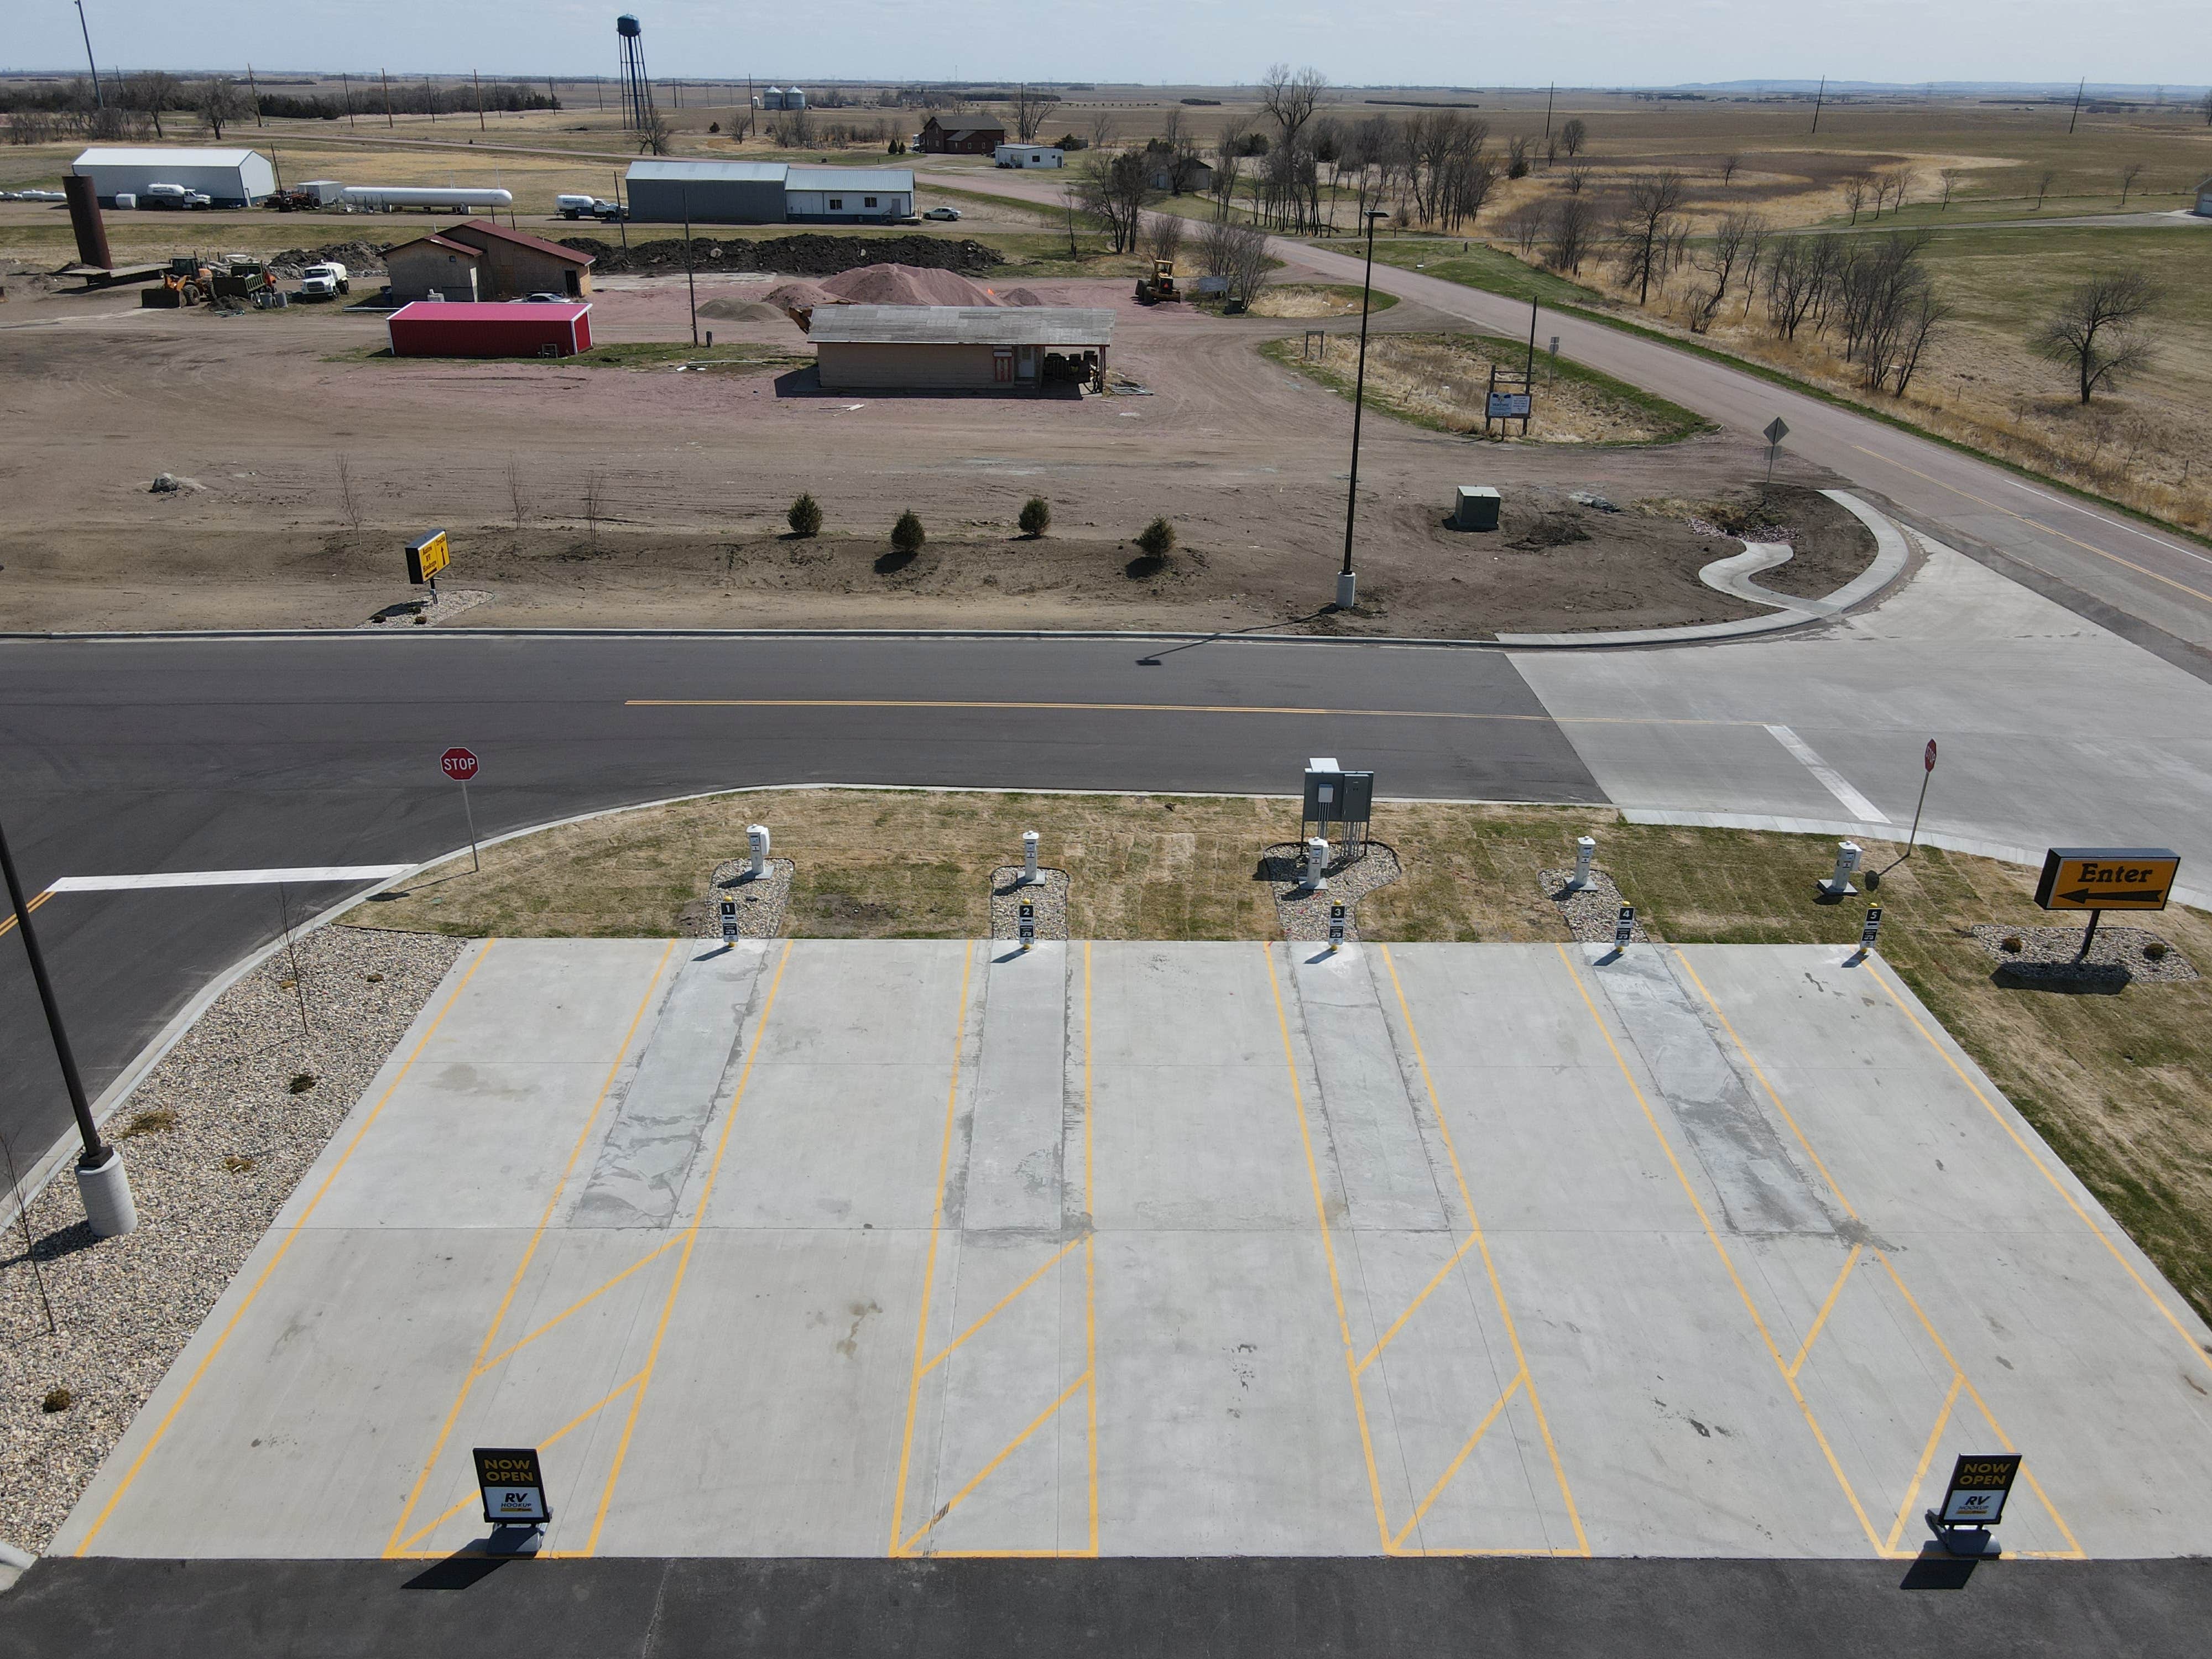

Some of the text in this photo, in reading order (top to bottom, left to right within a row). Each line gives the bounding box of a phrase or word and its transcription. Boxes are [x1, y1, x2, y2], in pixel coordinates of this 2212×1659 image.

[444, 758, 475, 770] STOP
[2077, 863, 2153, 883] Enter
[484, 1459, 530, 1469] NOW
[1964, 1463, 2011, 1473] NOW
[486, 1471, 534, 1481] OPEN
[1959, 1475, 2006, 1485] OPEN
[505, 1493, 528, 1503] RV
[1965, 1496, 1991, 1505] RV
